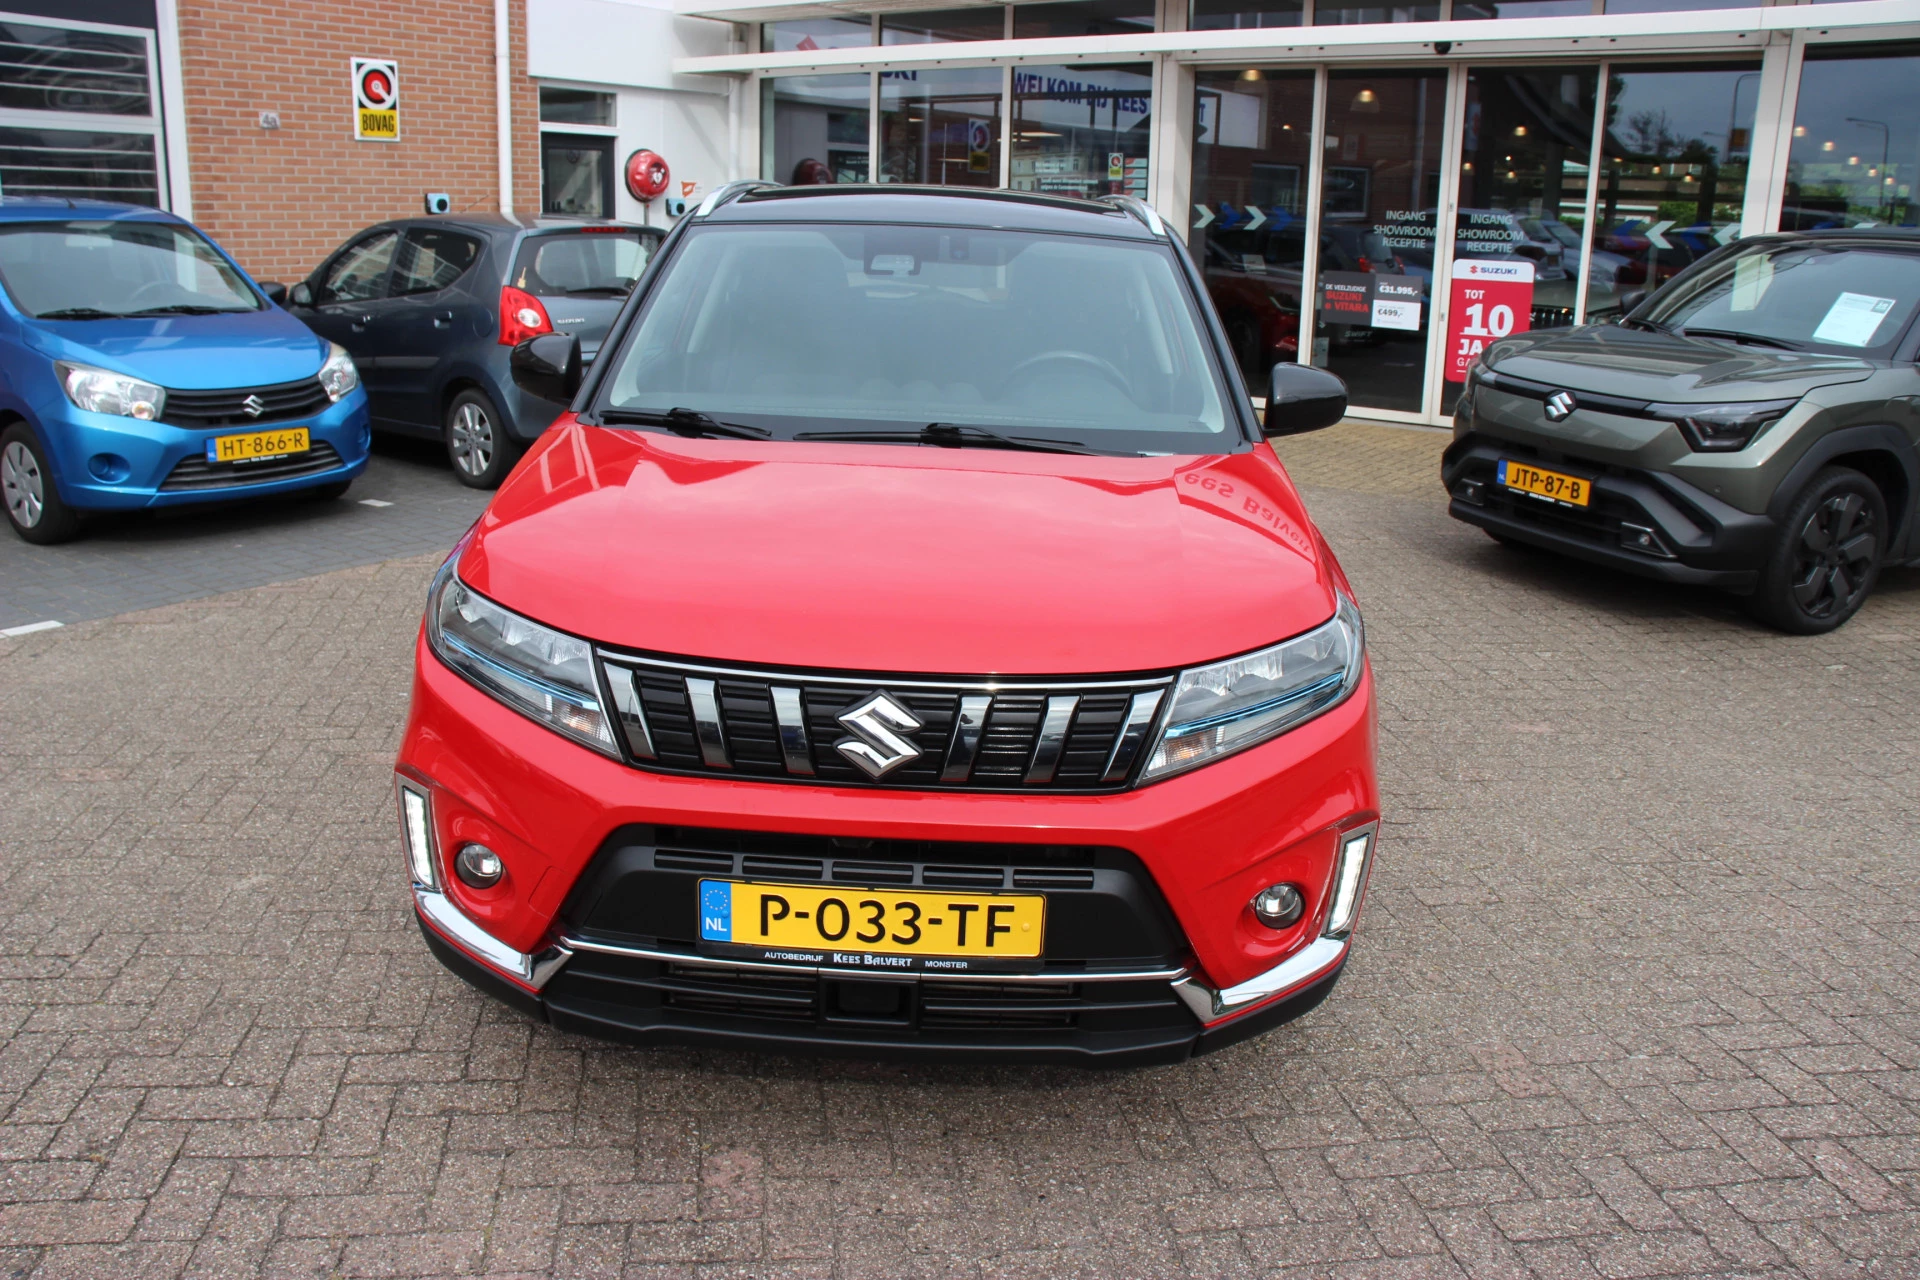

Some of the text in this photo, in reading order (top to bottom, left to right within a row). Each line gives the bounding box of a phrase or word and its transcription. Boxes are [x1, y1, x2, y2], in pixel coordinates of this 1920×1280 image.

[1015, 72, 1148, 114] WELKOM BIJ EES
[262, 113, 278, 127] 4a
[362, 113, 395, 132] BOVAG
[1386, 210, 1426, 222] INGANG
[1470, 213, 1513, 225] INGANG
[1373, 224, 1436, 237] SHOWROOM
[1457, 228, 1524, 241] SHOWROOM
[1382, 237, 1426, 249] RECEPTIE
[1466, 241, 1513, 253] RECEPTIE
[1480, 266, 1518, 275] SUZUKI
[1325, 290, 1362, 301] SUZUKI
[1380, 285, 1418, 296] €31.995,-
[1464, 289, 1485, 300] TOT
[1334, 301, 1369, 312] VITARA
[1377, 308, 1403, 317] €499,-
[1463, 303, 1514, 338] 10
[223, 432, 304, 457] HT-866-R
[1511, 467, 1580, 499] JTP-87-B
[705, 917, 727, 931] NL
[760, 893, 1015, 948] P-033-TF
[764, 951, 968, 969] AUTOBEDRIJF KEES BALVERT MONSTER
